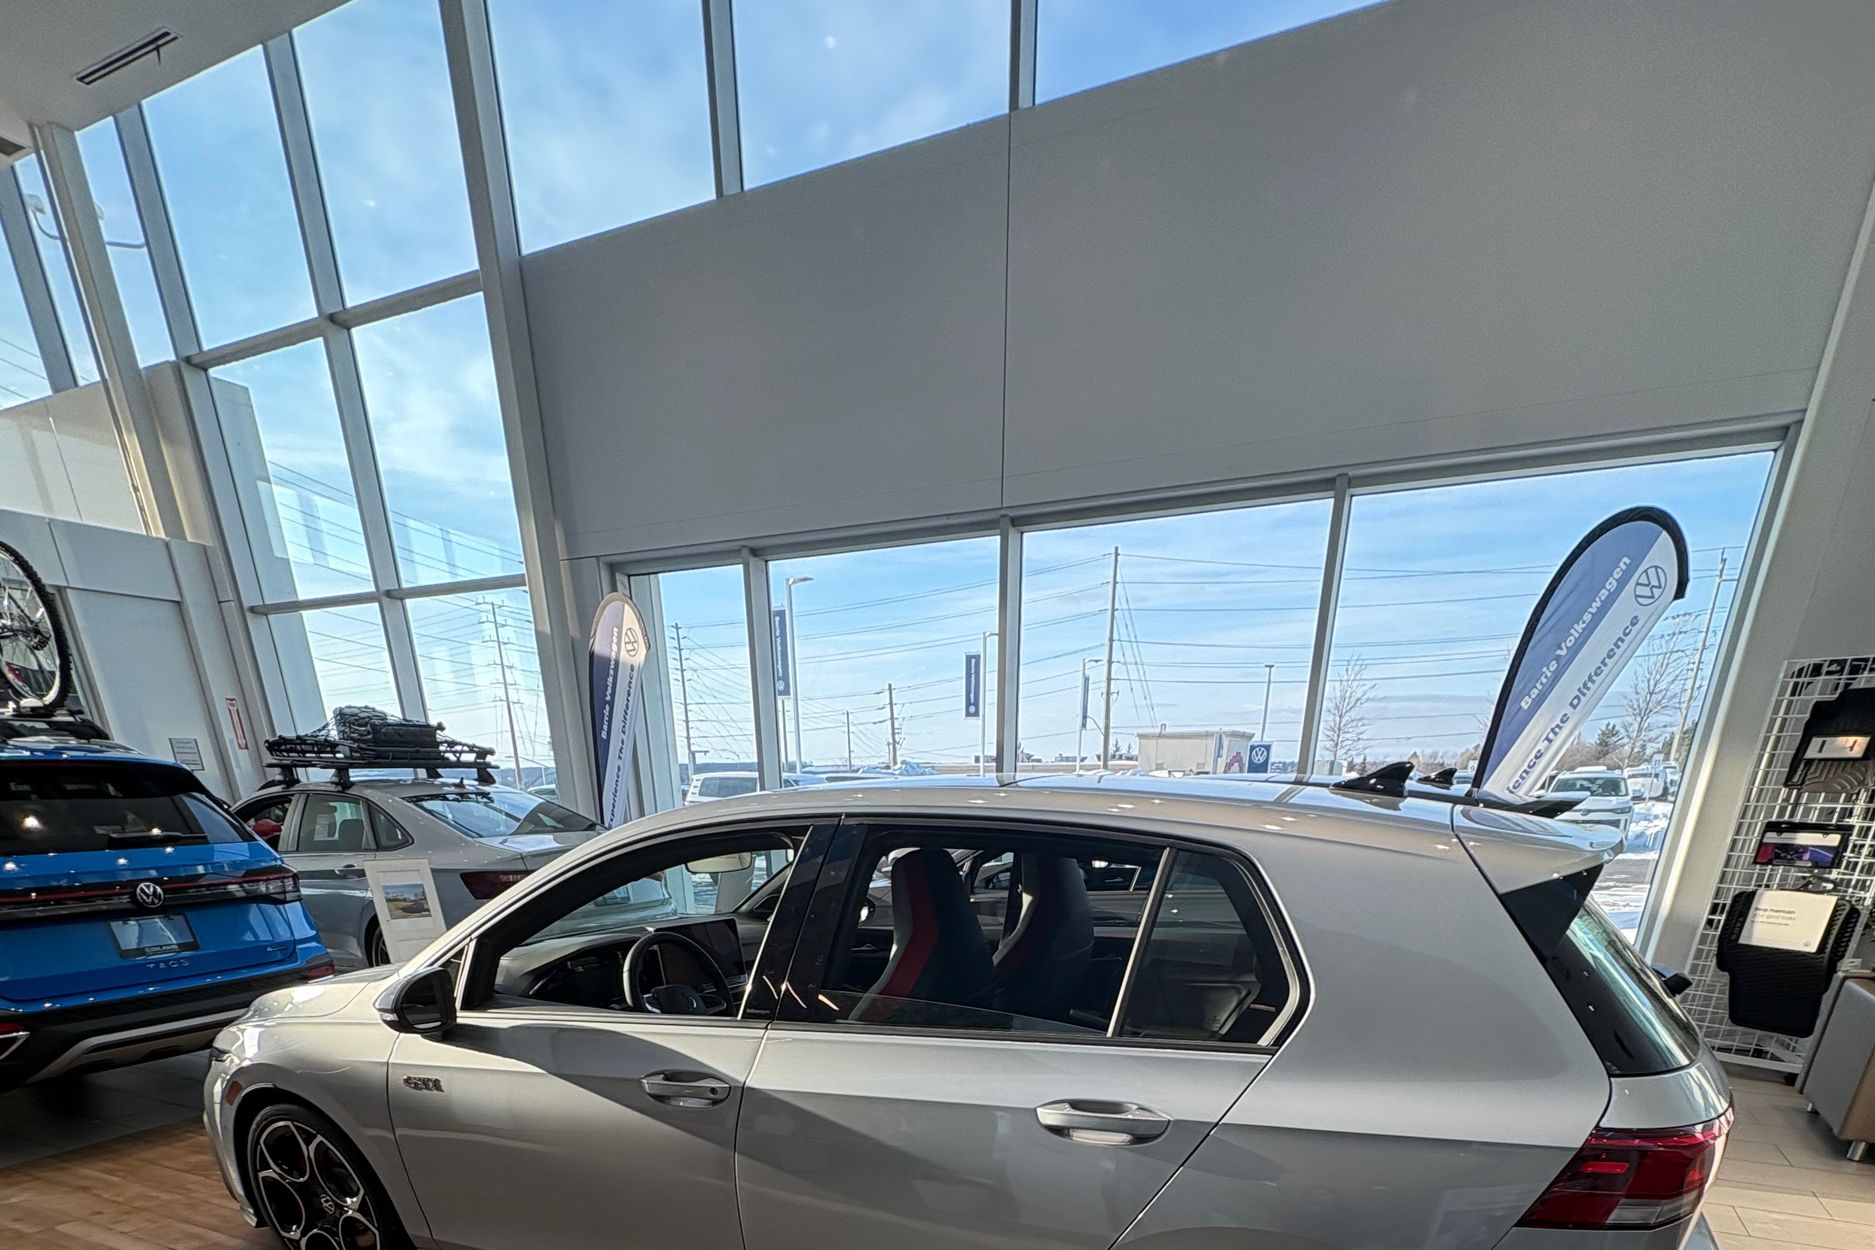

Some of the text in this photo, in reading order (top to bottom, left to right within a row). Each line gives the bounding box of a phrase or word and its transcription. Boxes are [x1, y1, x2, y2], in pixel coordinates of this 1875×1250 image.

[601, 627, 618, 740] Barrie Volkswagen
[1519, 555, 1631, 710] Barrie Volkswagen
[1543, 712, 1570, 747] The
[1570, 613, 1641, 711] Difference
[617, 738, 626, 761] The
[621, 664, 635, 736] Difference
